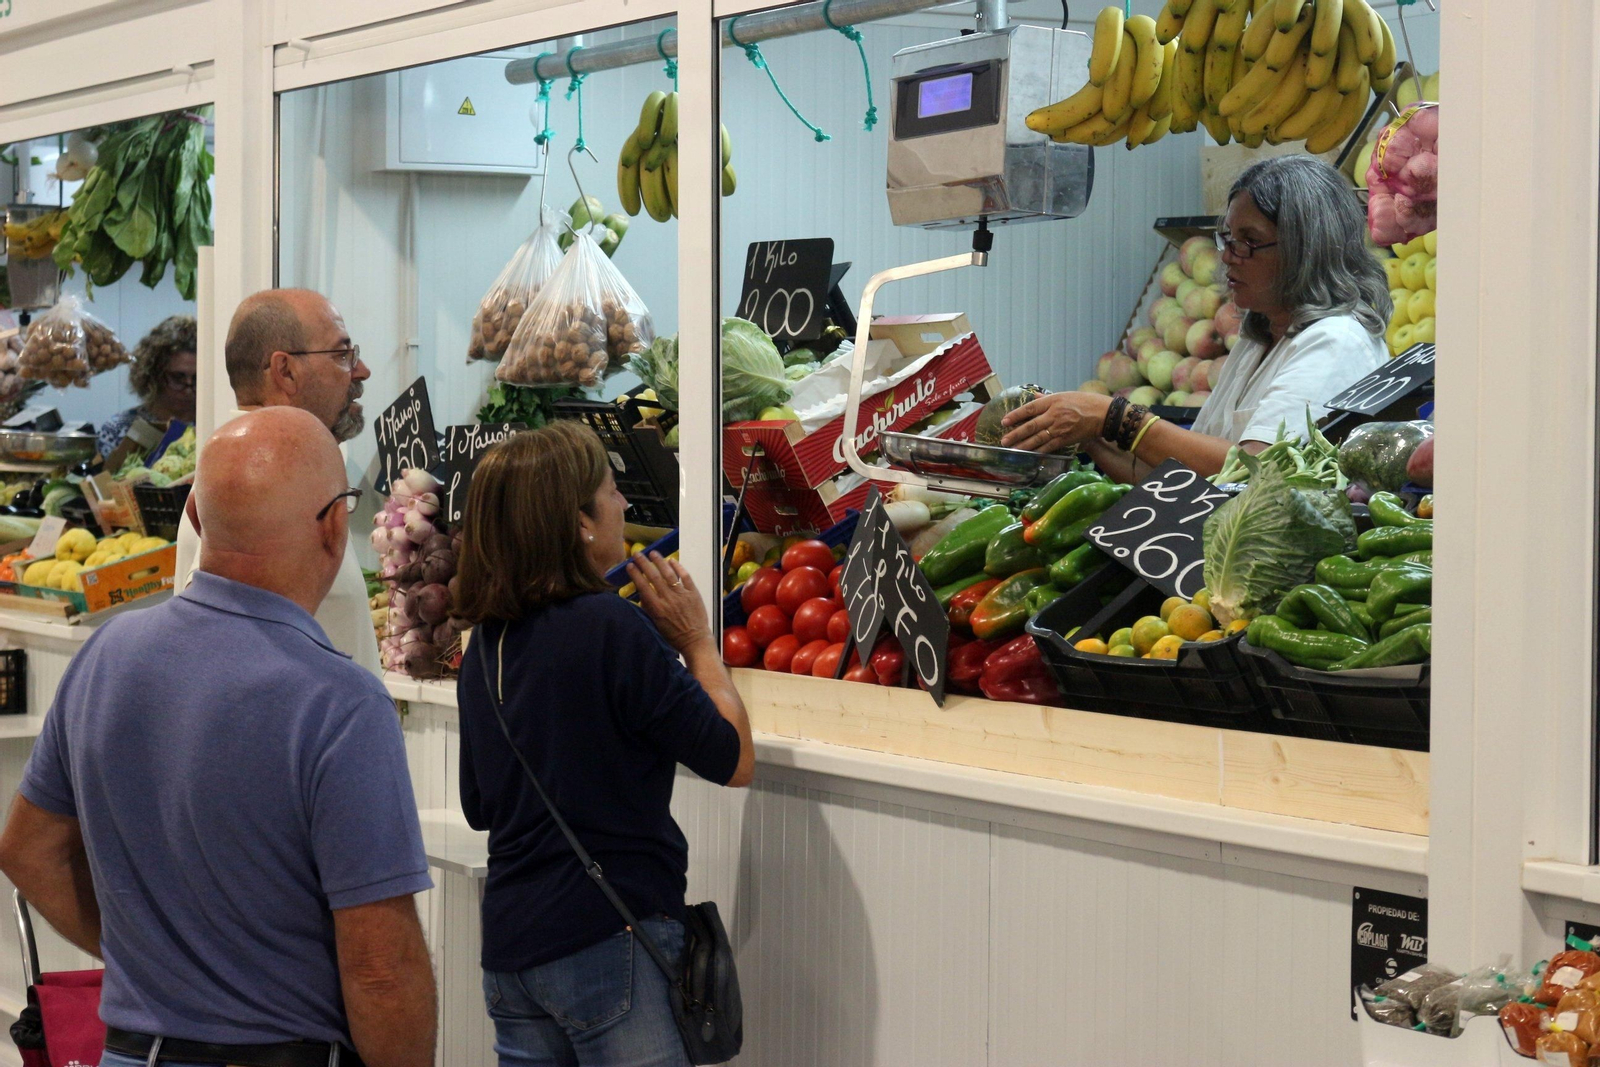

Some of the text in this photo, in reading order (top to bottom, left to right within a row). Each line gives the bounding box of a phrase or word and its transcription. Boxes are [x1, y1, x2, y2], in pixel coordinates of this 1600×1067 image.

[749, 242, 760, 279] 1
[378, 412, 387, 447] 1
[446, 425, 456, 461] 1
[1142, 469, 1197, 502] 2
[1368, 903, 1420, 922] PROPIEDAD DE:
